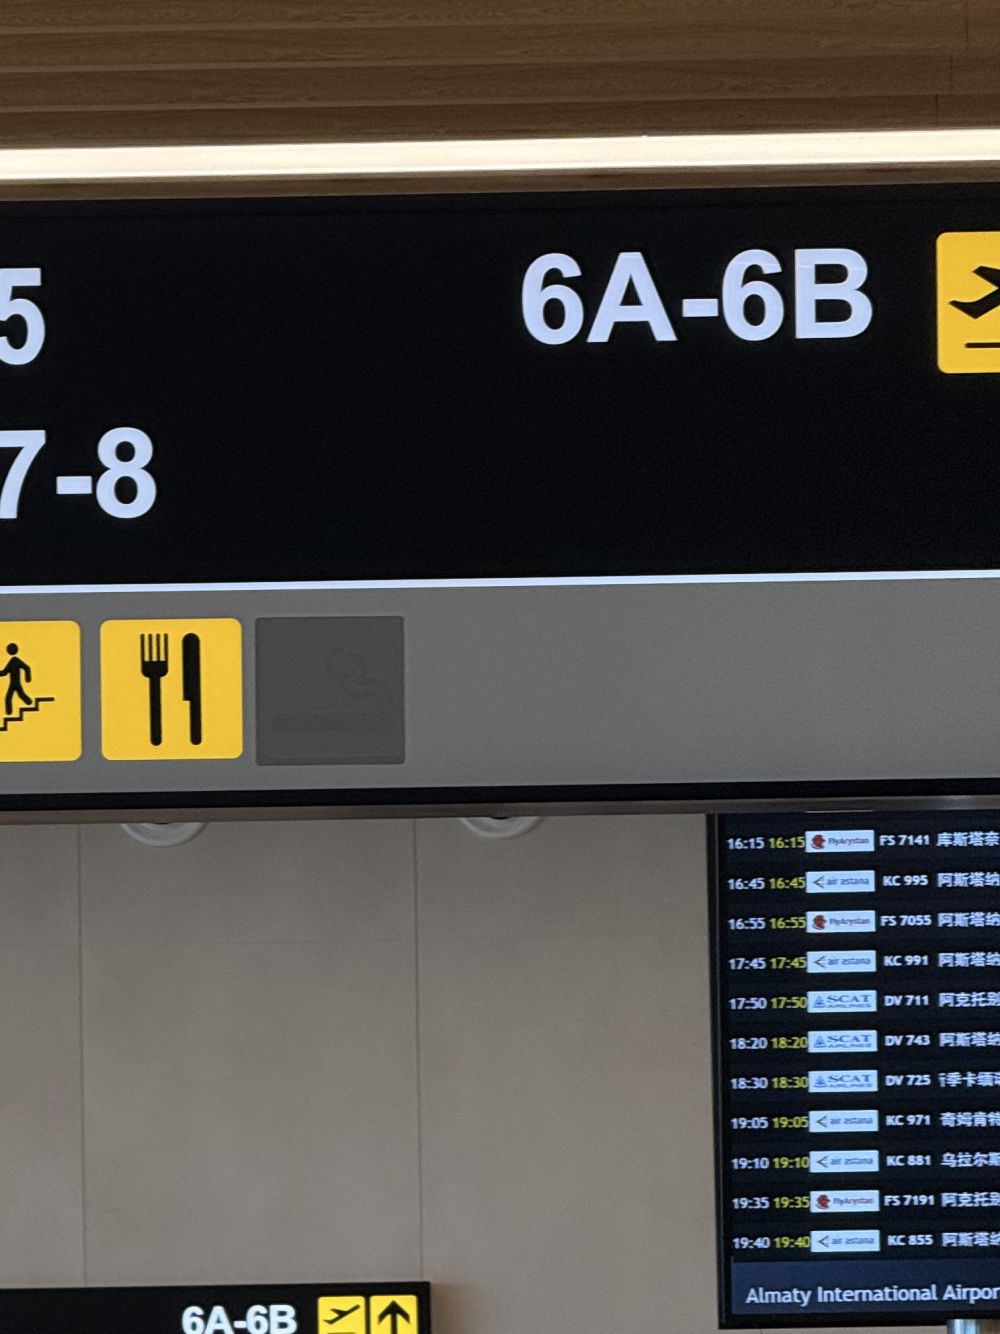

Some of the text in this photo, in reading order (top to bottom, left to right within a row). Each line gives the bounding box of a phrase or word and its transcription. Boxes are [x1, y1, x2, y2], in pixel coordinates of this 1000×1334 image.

[520, 248, 873, 346] 6A-6B
[727, 837, 764, 849] 16:15
[768, 837, 805, 849] 16:15
[879, 835, 895, 846] FS
[899, 835, 929, 846] 7141
[728, 878, 765, 890] 16:45
[769, 877, 805, 889] 16:45
[883, 875, 901, 886] KC
[905, 875, 928, 886] 995
[728, 918, 765, 930] 16:55
[770, 917, 806, 928] 16:55
[880, 916, 896, 927] FS
[900, 915, 931, 926] 7055
[728, 958, 766, 970] 17:45
[771, 957, 807, 969] 17:45
[884, 956, 902, 966] KC
[905, 955, 928, 966] 991
[729, 998, 767, 1010] 17:50
[771, 997, 807, 1009] 17:50
[884, 996, 902, 1006] DV
[905, 995, 929, 1006] 711
[729, 1038, 768, 1050] 18:20
[772, 1037, 808, 1049] 18:20
[885, 1036, 902, 1046] DV
[906, 1035, 930, 1046] 743
[730, 1078, 768, 1089] 18:30
[772, 1077, 808, 1088] 18:30
[885, 1075, 903, 1086] DV
[906, 1075, 931, 1086] 725
[731, 1118, 768, 1129] 19:05
[772, 1117, 808, 1128] 19:05
[886, 1115, 903, 1126] KC
[908, 1115, 931, 1126] 971
[731, 1158, 769, 1169] 19:10
[773, 1157, 809, 1168] 19:10
[887, 1156, 904, 1166] KC
[908, 1155, 931, 1166] 881
[732, 1198, 770, 1209] 19:35
[774, 1197, 809, 1208] 19:35
[884, 1195, 900, 1206] FS
[904, 1195, 935, 1206] 7191
[733, 1238, 770, 1249] 19:40
[775, 1236, 810, 1248] 19:40
[888, 1235, 906, 1246] KC
[909, 1235, 933, 1246] 855
[746, 1285, 1000, 1307] Almaty International Airpor
